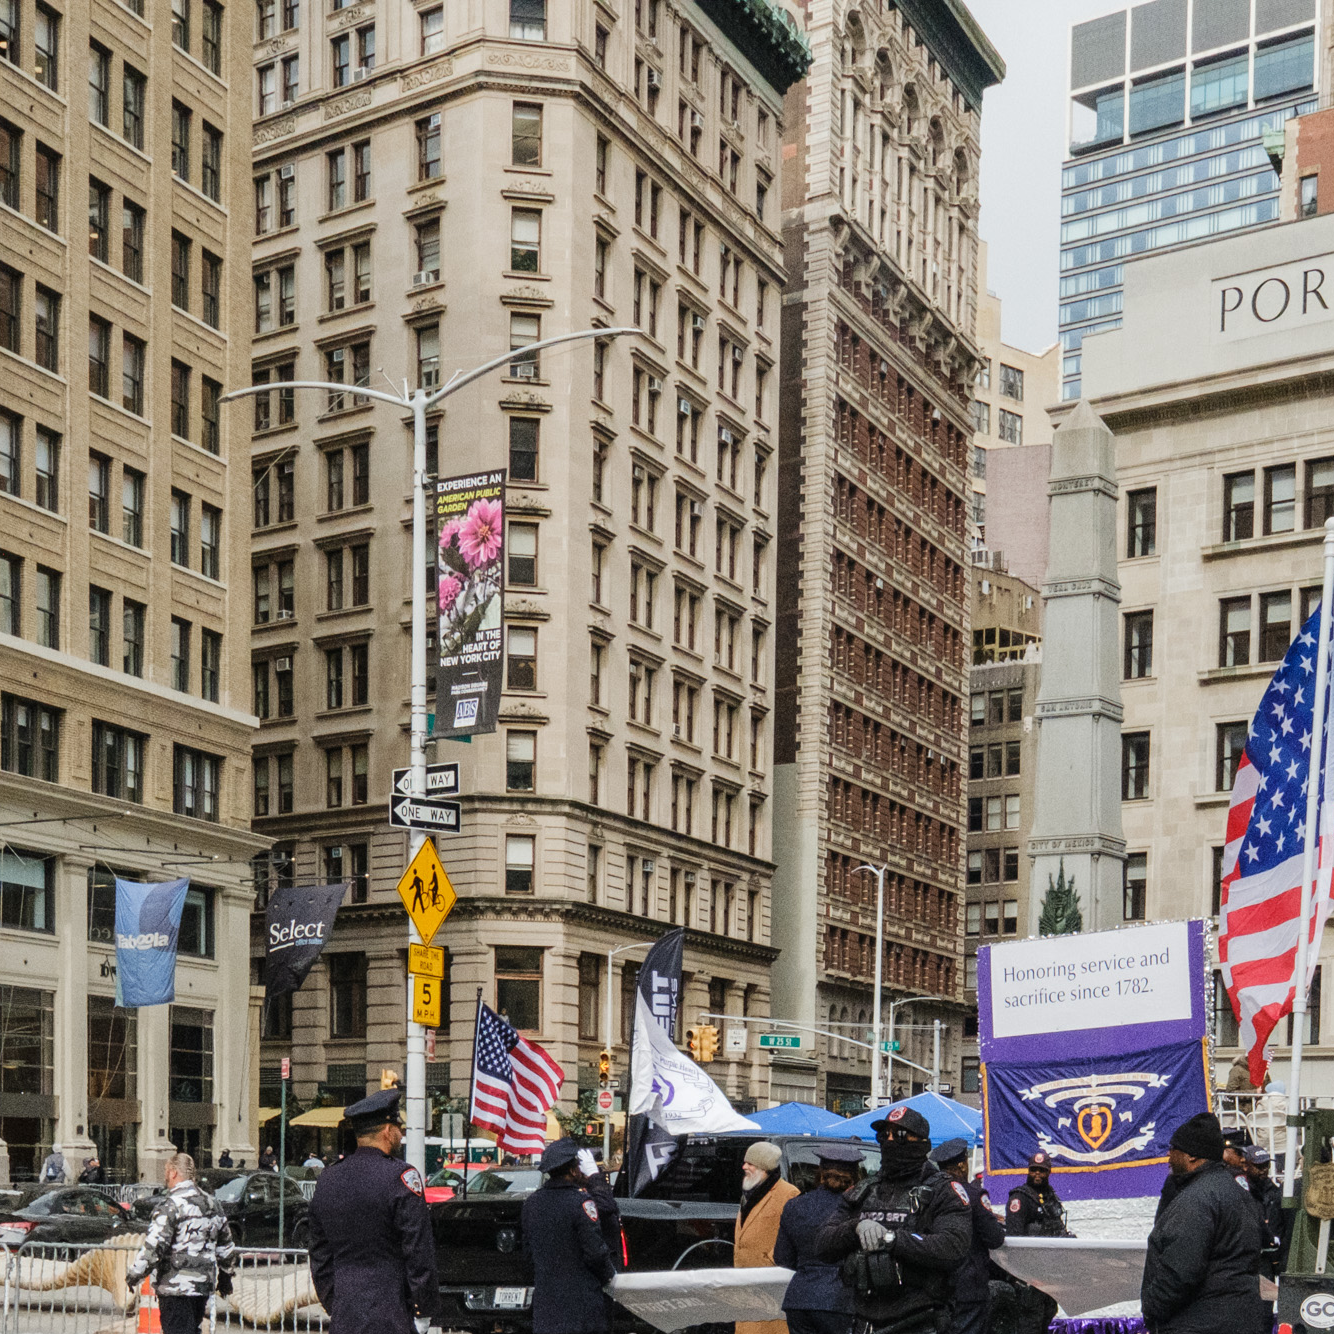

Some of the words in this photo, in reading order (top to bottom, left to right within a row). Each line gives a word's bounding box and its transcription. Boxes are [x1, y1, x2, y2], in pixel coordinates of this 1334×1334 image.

[437, 475, 488, 492] EXPERIENCE
[489, 473, 502, 484] AN
[1051, 479, 1095, 491] MONTEREY
[437, 490, 475, 504] AMERICAN
[475, 487, 501, 498] PUBLIC
[437, 502, 468, 514] GARDEN
[476, 631, 484, 642] IN
[485, 629, 501, 640] THE
[462, 641, 488, 653] HEART
[489, 640, 501, 650] OF
[440, 655, 459, 667] NEW
[460, 653, 482, 664] YORK
[483, 650, 501, 661] CITY
[457, 700, 478, 718] ABS
[1040, 703, 1056, 713] SAN
[1059, 700, 1093, 711] ANTONIO
[430, 773, 451, 787] WAY
[401, 805, 421, 819] ONE
[430, 809, 452, 822] WAY
[1031, 840, 1048, 850] CITY
[1051, 840, 1062, 849] OF
[1065, 838, 1095, 848] MEXICO
[269, 919, 325, 945] Select
[117, 932, 169, 950] Taboola
[413, 947, 429, 959] SHARE
[430, 950, 440, 961] THE
[419, 960, 433, 972] ROAD
[1003, 961, 1076, 984] Honoring
[1080, 953, 1135, 975] service
[1139, 946, 1170, 967] and
[422, 983, 432, 1006] 5
[1004, 987, 1065, 1009] sacrifice
[1070, 983, 1110, 1001] since
[1114, 976, 1154, 996] 1782.
[769, 1037, 776, 1046] W
[776, 1037, 784, 1047] 25
[880, 1042, 886, 1050] W
[886, 1042, 894, 1050] 25
[660, 1056, 679, 1069] Purple
[885, 1212, 908, 1223] SRT
